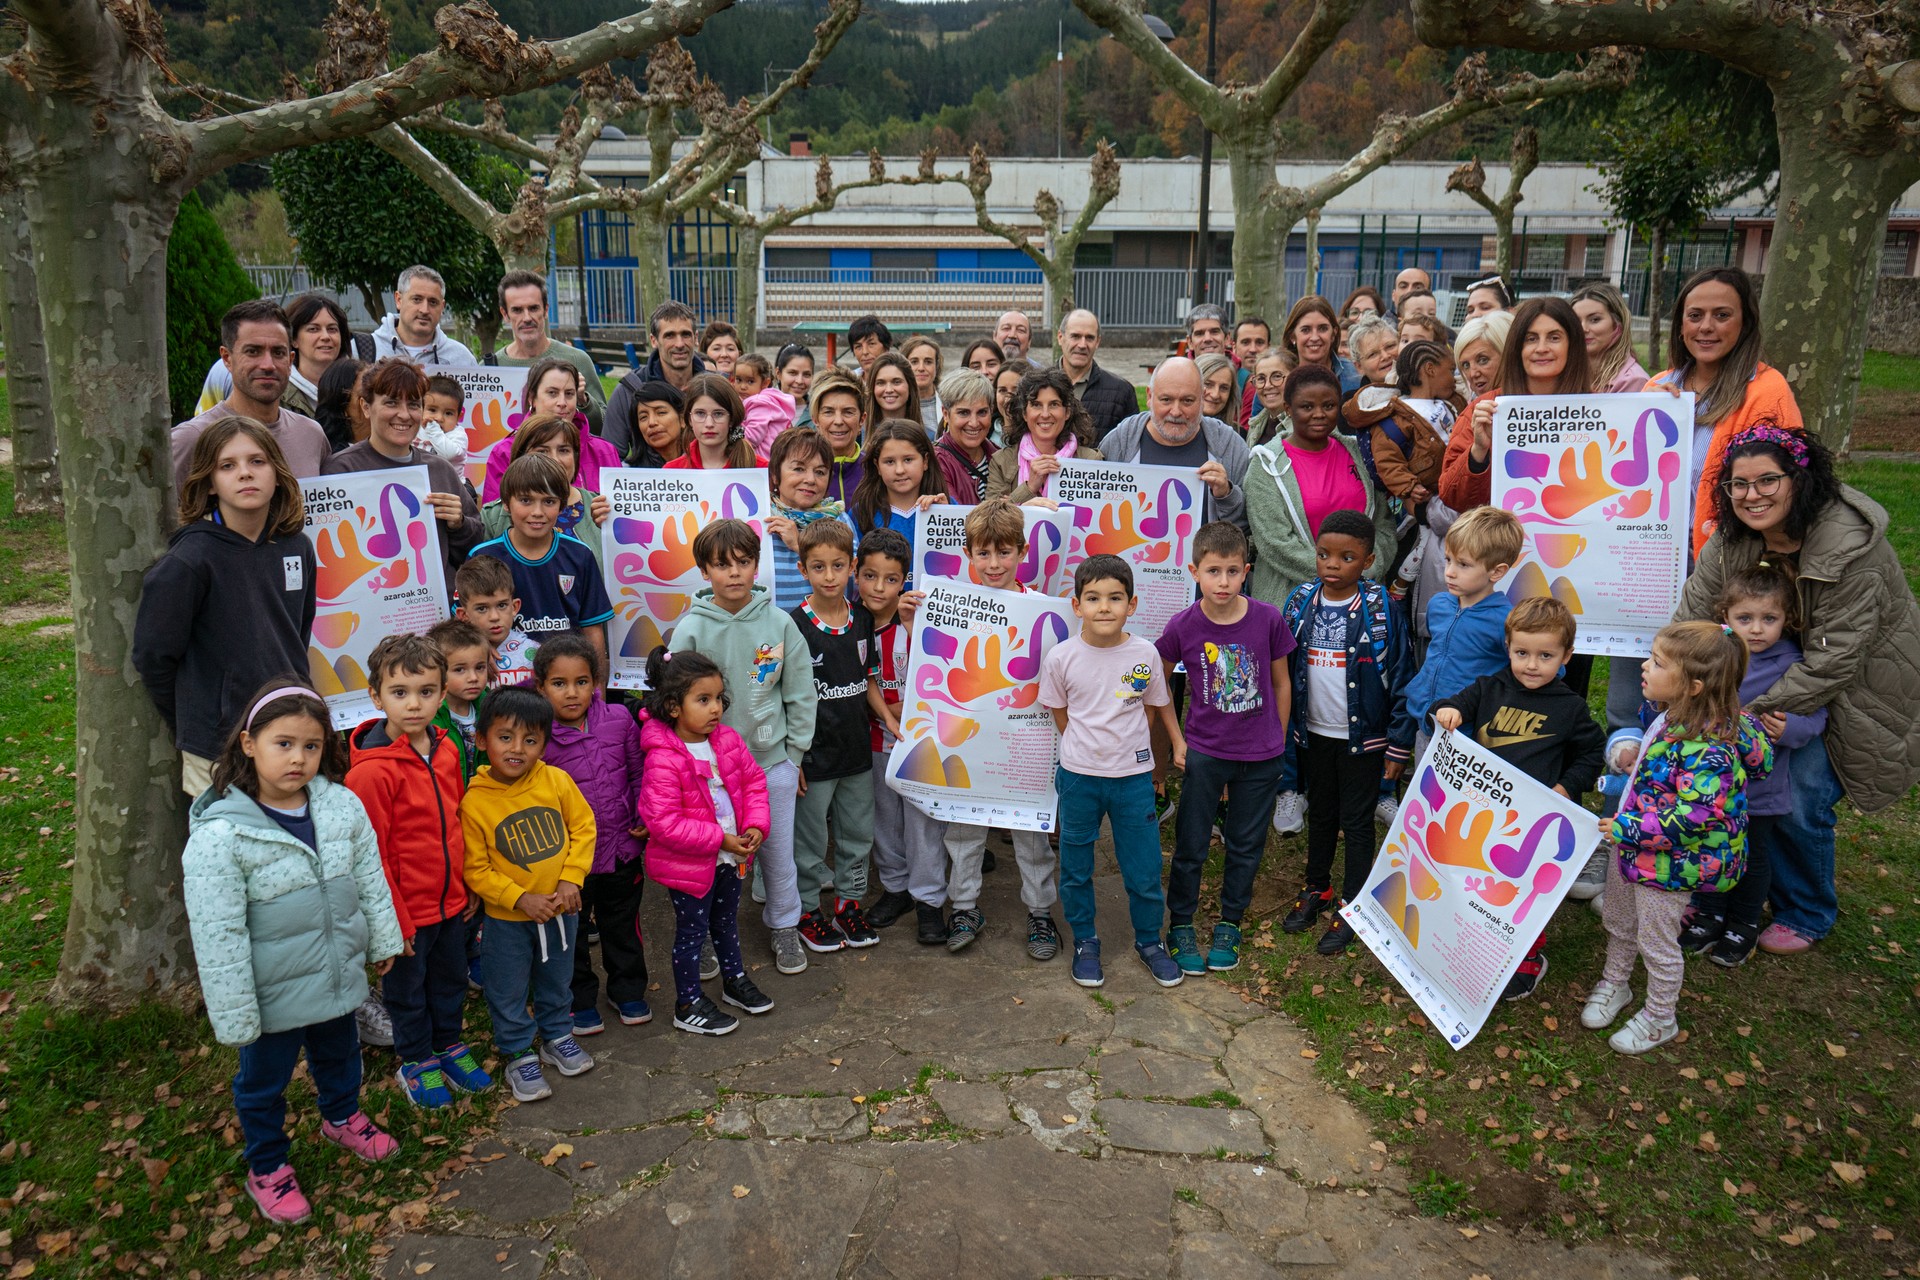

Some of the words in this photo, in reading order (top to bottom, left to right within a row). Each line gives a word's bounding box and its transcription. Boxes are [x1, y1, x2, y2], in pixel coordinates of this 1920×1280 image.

[1507, 406, 1602, 420] Aiaraldeko
[1507, 419, 1606, 432] euskararen
[1507, 433, 1560, 447] eguna
[1562, 434, 1590, 443] 2025
[1060, 468, 1134, 482] Aiaraldeko
[612, 479, 694, 492] Aiaraldeko
[1059, 479, 1137, 492] euskararen
[614, 490, 699, 502] euskararen
[1059, 490, 1101, 501] eguna
[1103, 492, 1124, 500] 2025
[614, 502, 661, 515] eguna
[664, 504, 686, 512] 2025
[315, 514, 340, 525] 2025
[384, 590, 415, 601] azaroak
[405, 595, 434, 605] okondo
[929, 588, 1005, 613] Aiaraldeko
[928, 601, 1008, 626] euskararen
[926, 612, 968, 629] eguna
[970, 622, 993, 634] 2025
[1314, 659, 1337, 667] 1983
[814, 678, 868, 700] Kutxabank
[1489, 706, 1548, 736] NIKE
[1441, 730, 1513, 792] Aiaraldeko
[1433, 752, 1463, 791] eguna
[1463, 786, 1490, 808] 2025
[1438, 742, 1512, 807] euskararen
[503, 812, 560, 860] HELLO
[1469, 901, 1501, 926] azaroak
[1502, 923, 1514, 934] 30
[1484, 922, 1514, 945] okondo
